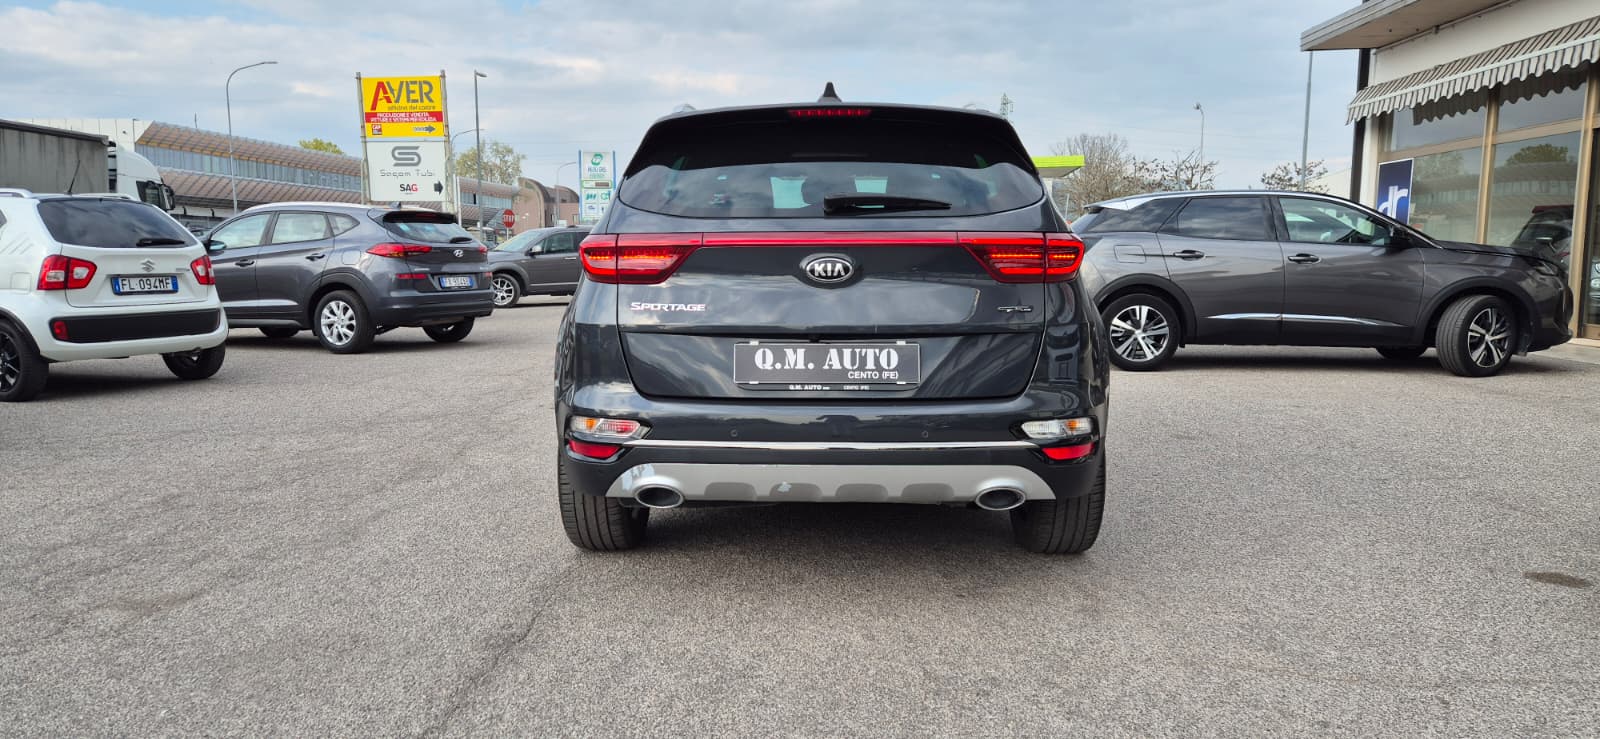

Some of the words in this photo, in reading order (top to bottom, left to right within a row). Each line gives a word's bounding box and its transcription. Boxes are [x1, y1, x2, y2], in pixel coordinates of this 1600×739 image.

[370, 80, 435, 111] AVER
[399, 183, 418, 192] SAG
[503, 214, 514, 223] STOP
[813, 262, 846, 277] KIA
[120, 278, 135, 290] FL
[138, 277, 170, 290] 094MF
[630, 302, 706, 312] SPORTAGE
[754, 348, 815, 370] Q.M.
[823, 348, 899, 370] AUTO
[847, 371, 879, 379] CENTO
[881, 371, 899, 379] (FE)
